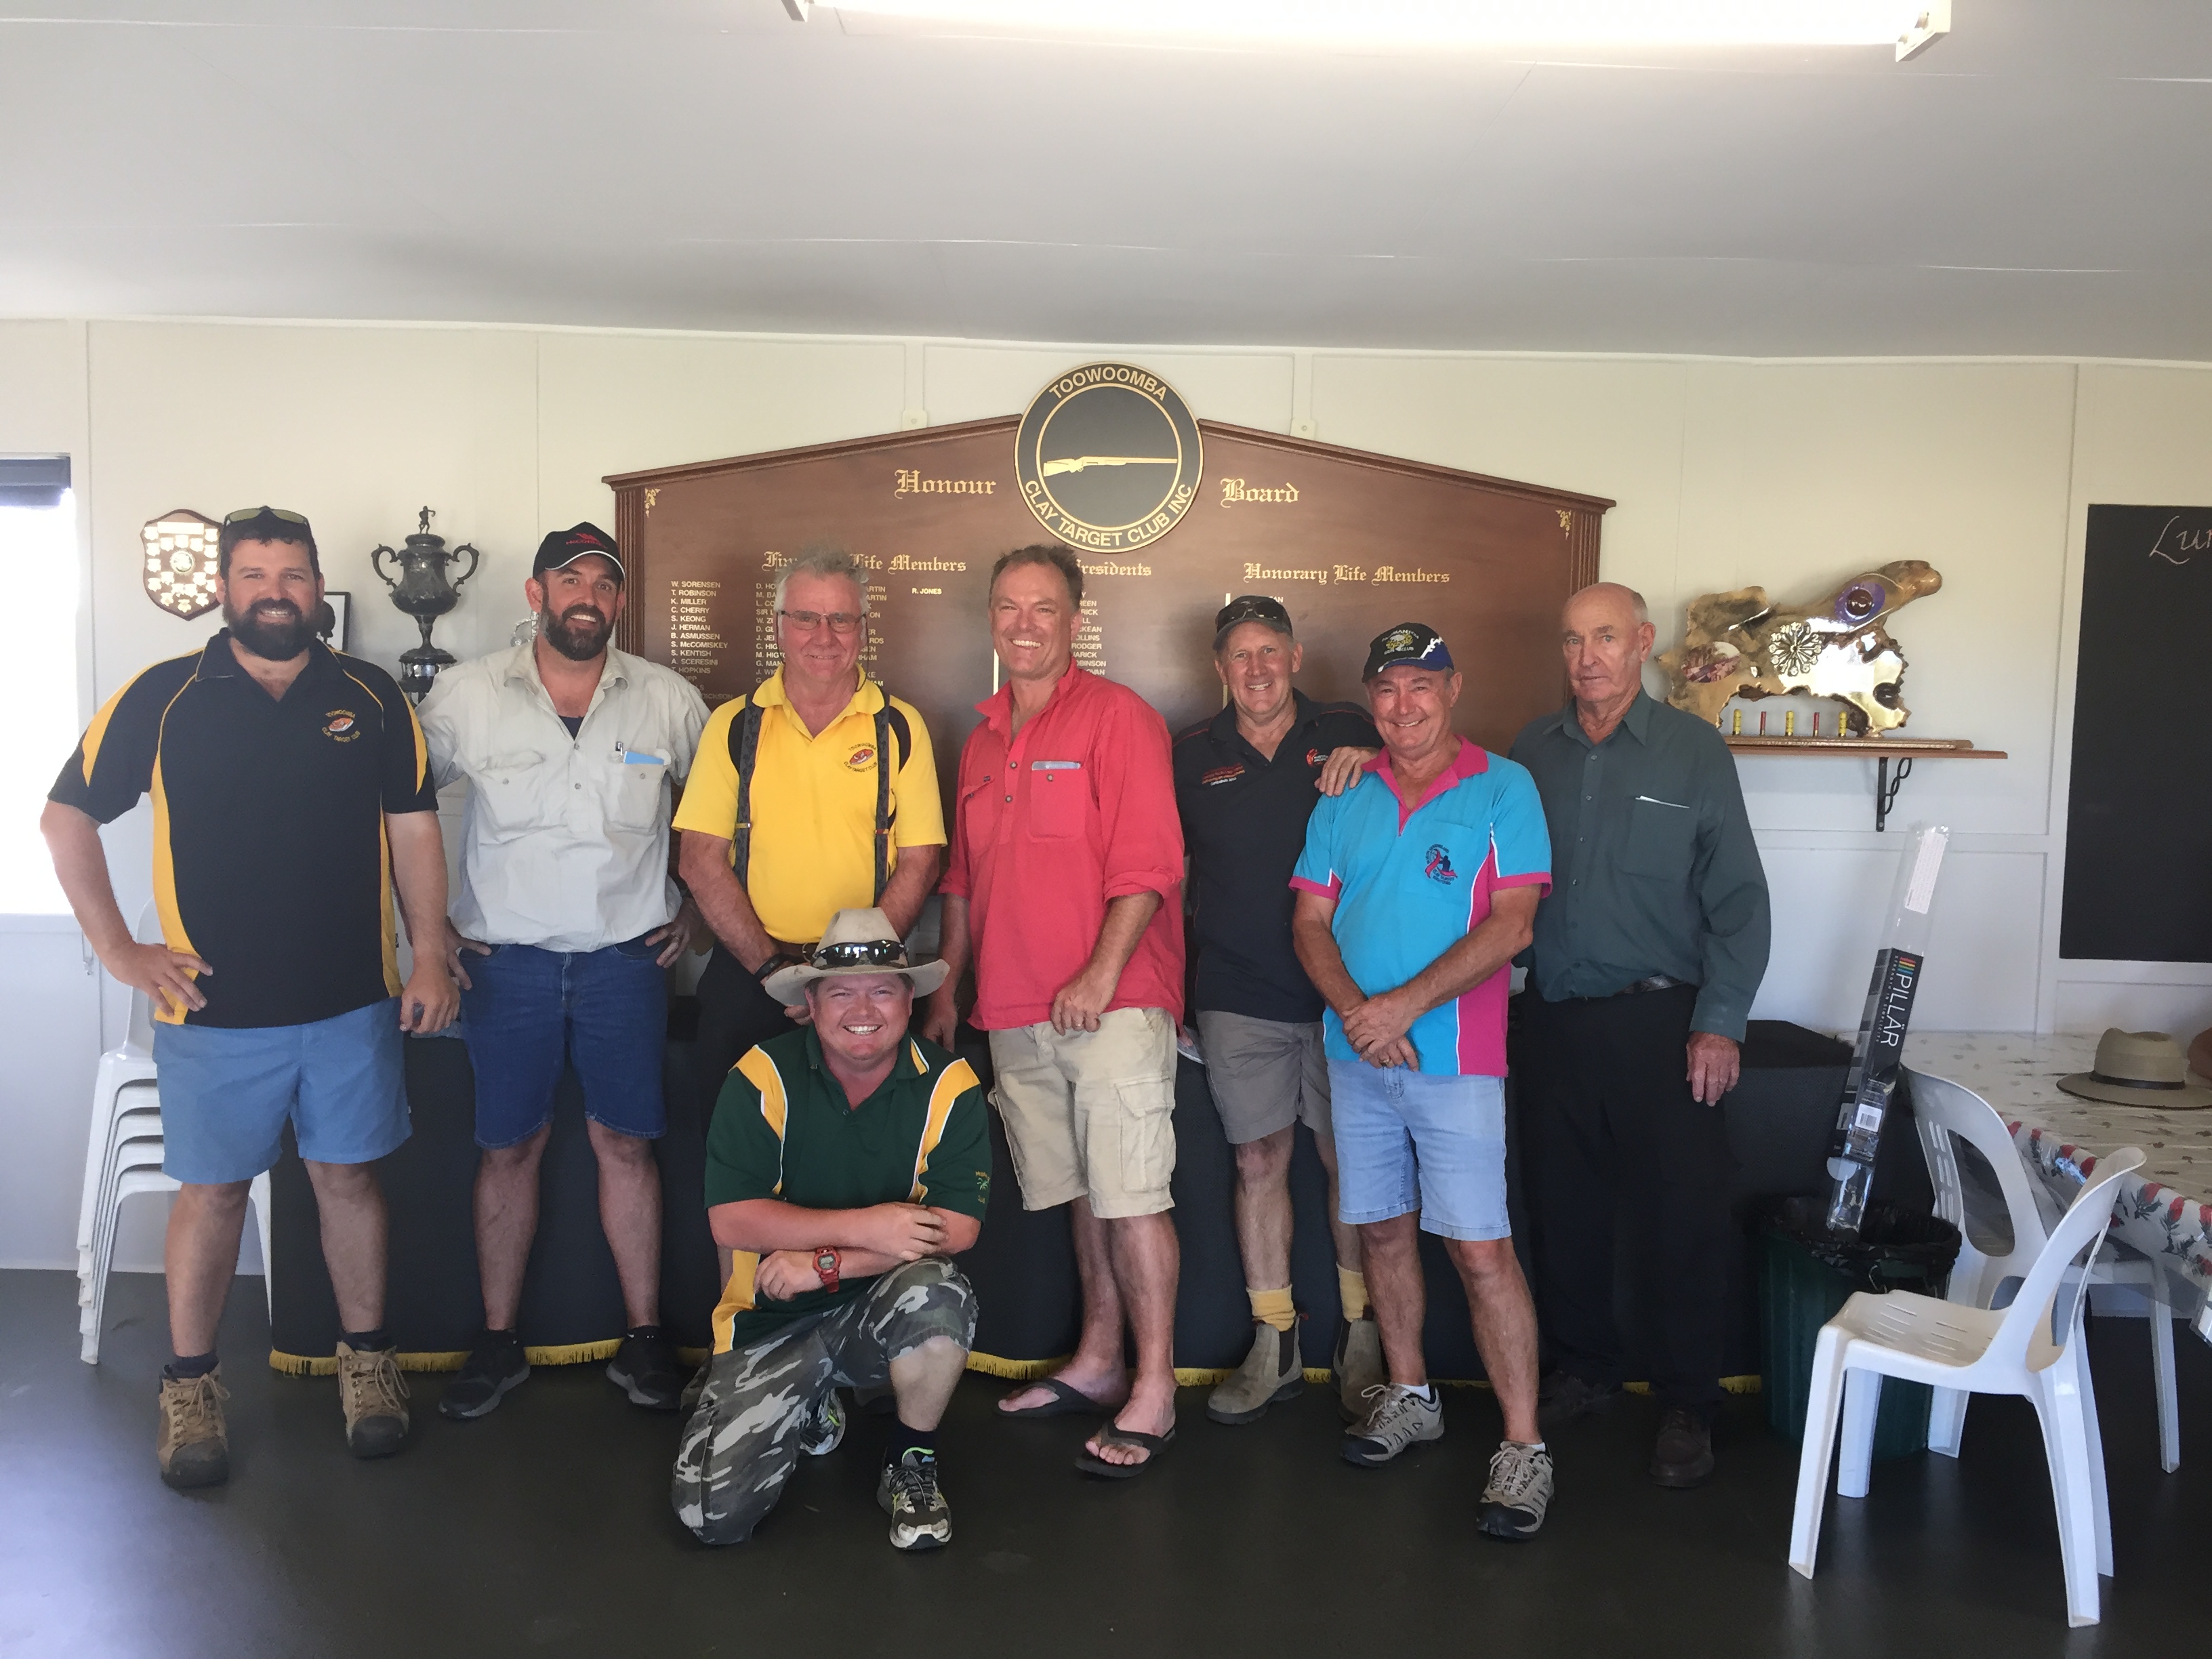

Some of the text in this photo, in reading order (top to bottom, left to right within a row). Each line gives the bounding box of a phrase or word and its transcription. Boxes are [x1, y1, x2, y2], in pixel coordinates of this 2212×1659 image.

[1049, 367, 1167, 401] TOOWOOMBA
[894, 469, 1300, 508] Honour Board
[1025, 480, 1192, 546] CLAY TARGET CLUB INC
[887, 554, 966, 575] Members
[1076, 558, 1152, 576] residents
[1244, 562, 1450, 586] Honorary Life Members
[1771, 633, 1782, 642] 10
[1791, 621, 1802, 631] 12
[1881, 973, 1912, 1046] PILLÄR
